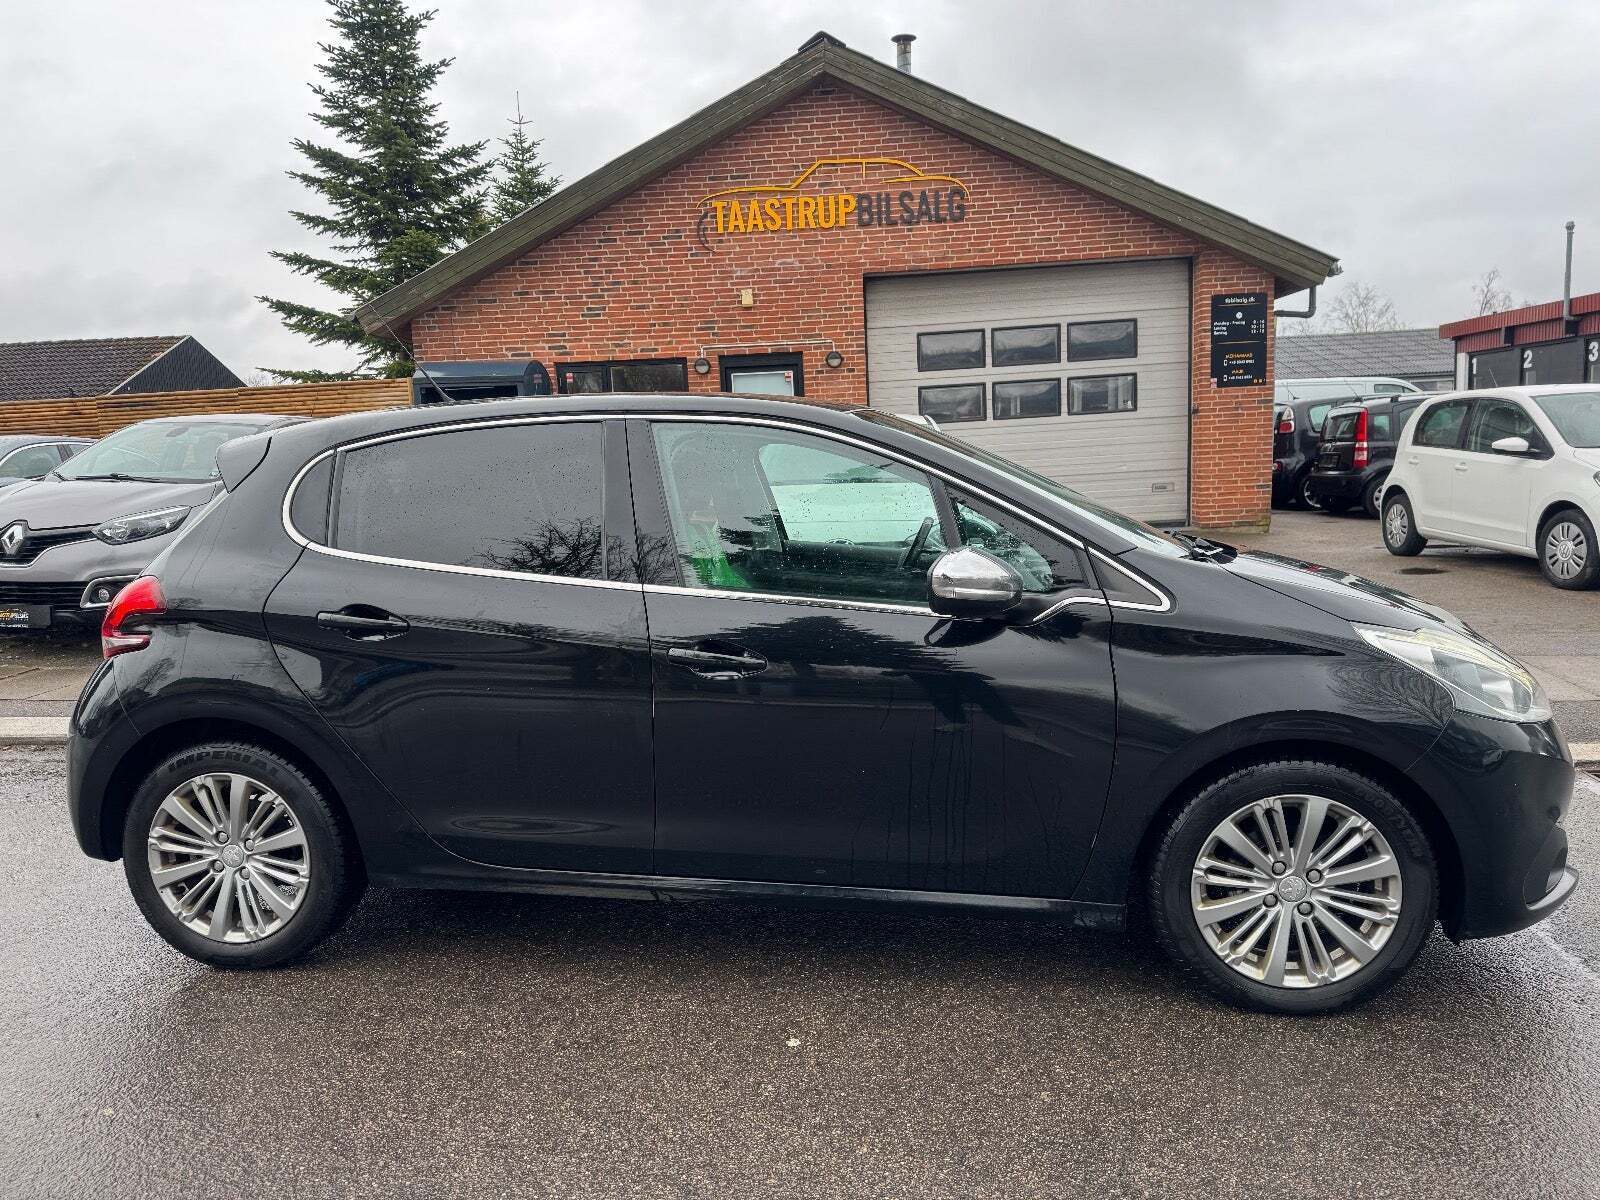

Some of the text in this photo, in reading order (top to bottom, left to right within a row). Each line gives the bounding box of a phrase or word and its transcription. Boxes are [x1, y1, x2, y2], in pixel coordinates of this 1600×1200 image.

[1523, 350, 1533, 369] 2
[1588, 341, 1599, 362] 3
[1471, 357, 1478, 375] 1
